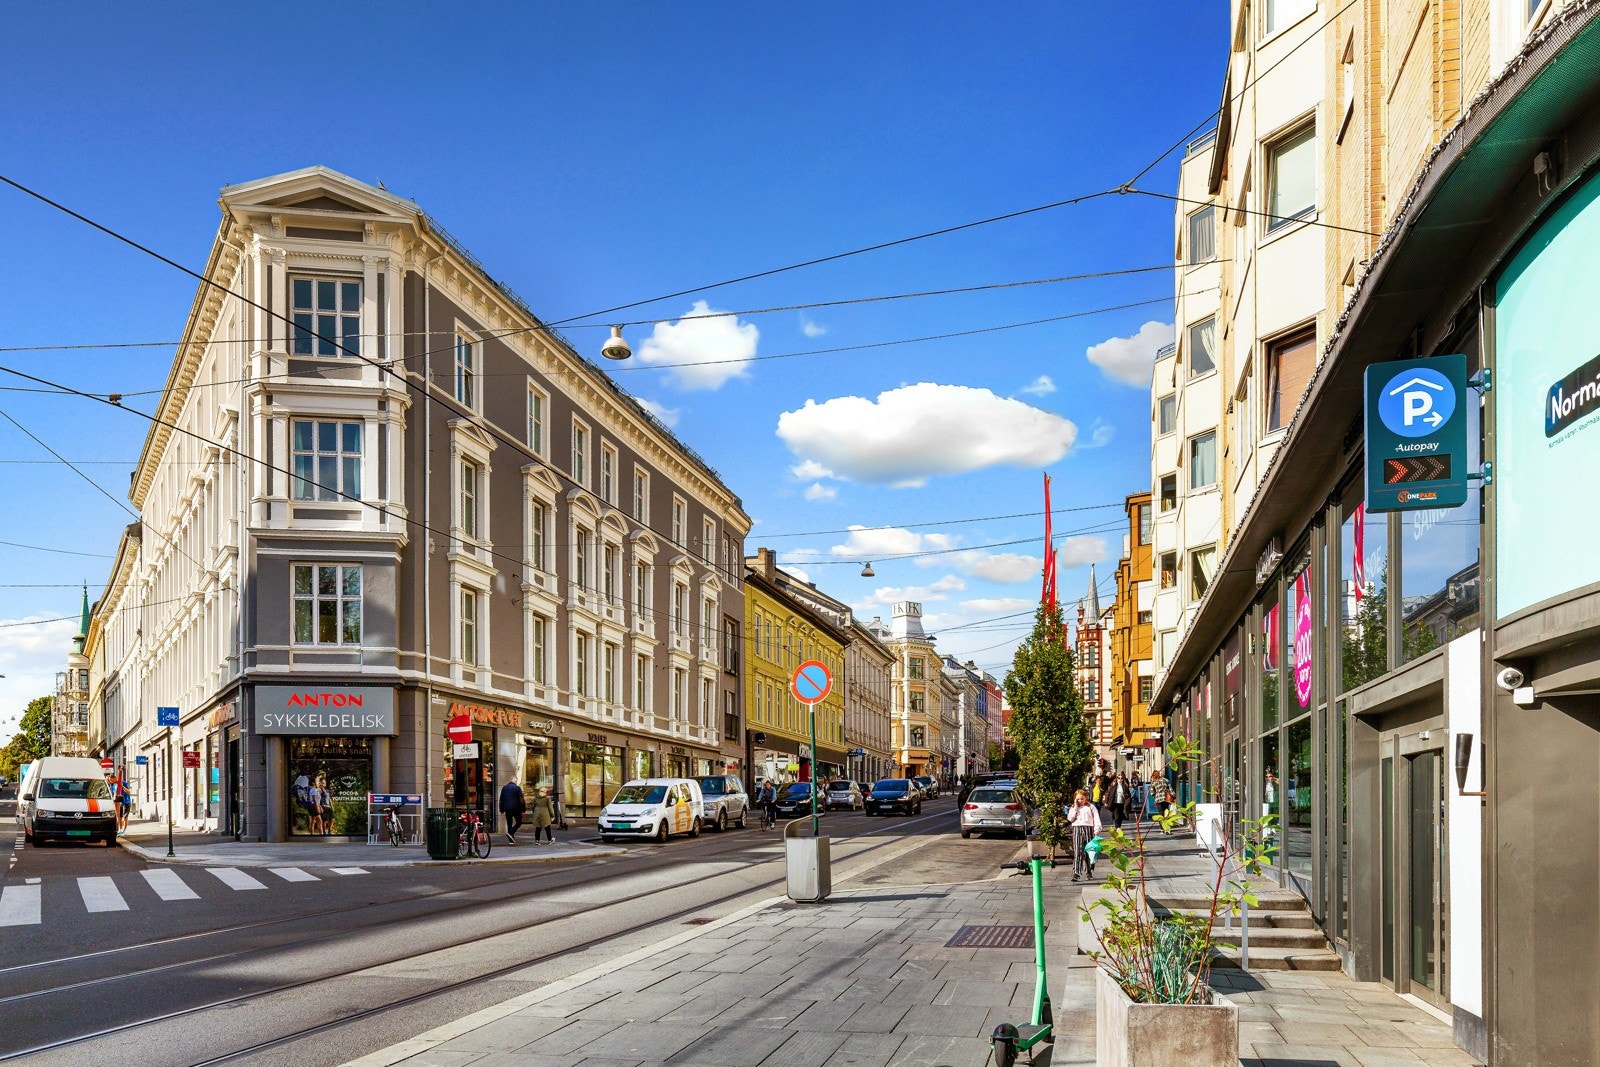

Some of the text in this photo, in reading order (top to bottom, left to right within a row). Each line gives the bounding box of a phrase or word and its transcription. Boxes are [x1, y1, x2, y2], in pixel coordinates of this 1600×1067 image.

[1403, 390, 1433, 426] P
[1395, 441, 1439, 453] Autopay
[286, 692, 364, 708] ANTON
[263, 713, 385, 728] SYKKELDELISK
